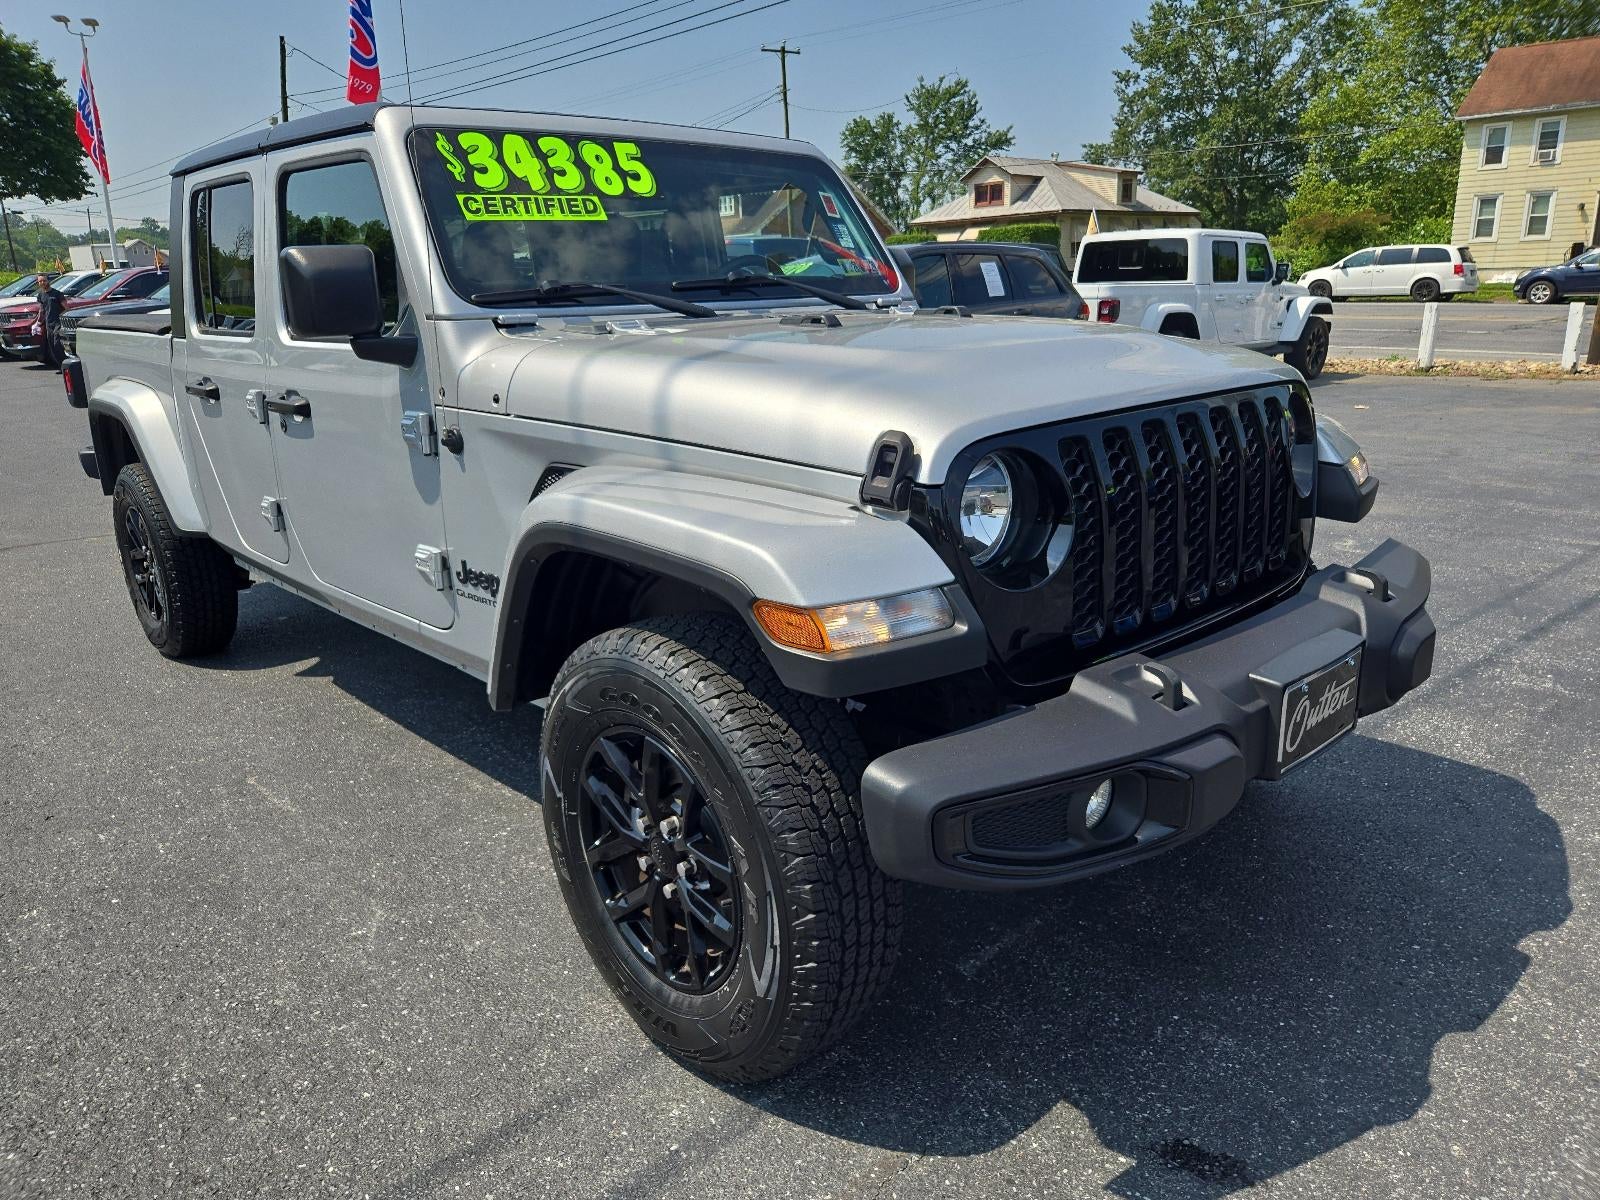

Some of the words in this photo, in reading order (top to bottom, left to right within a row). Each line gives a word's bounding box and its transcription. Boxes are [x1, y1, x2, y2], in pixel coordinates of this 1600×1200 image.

[349, 76, 373, 94] 1979
[435, 131, 657, 197] $34385
[462, 195, 600, 217] CERTIFIED
[456, 560, 500, 598] Jeep
[456, 589, 498, 608] GLADIATO
[1286, 676, 1356, 753] Outten
